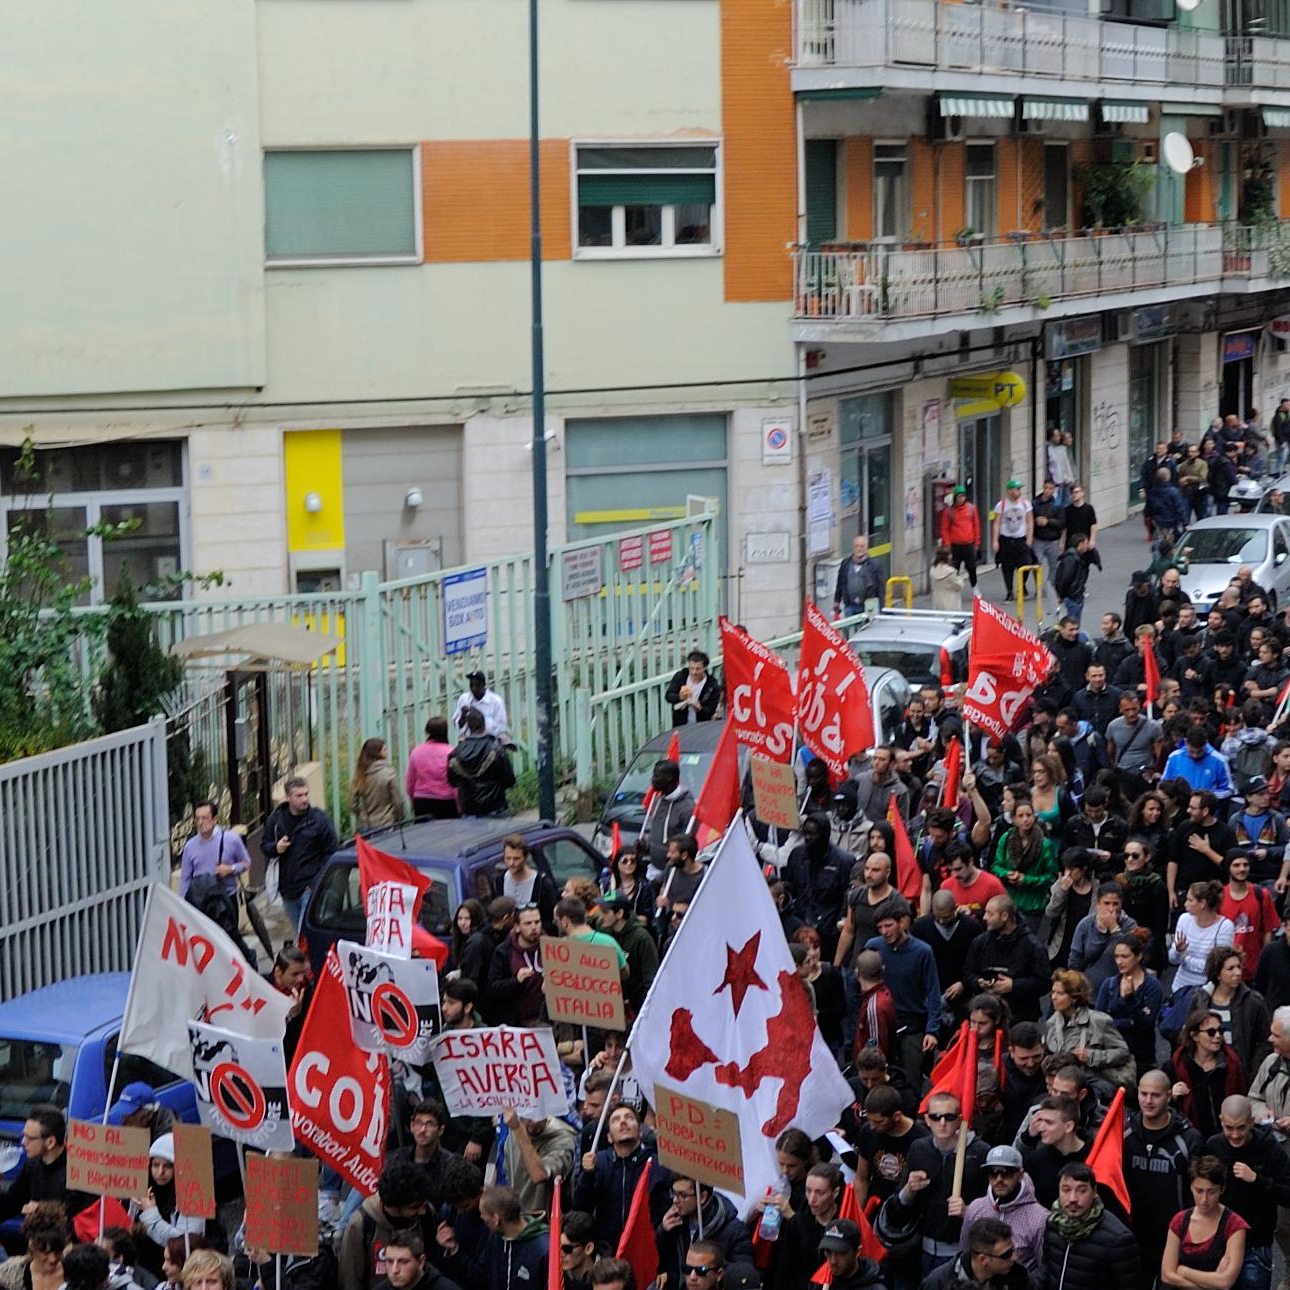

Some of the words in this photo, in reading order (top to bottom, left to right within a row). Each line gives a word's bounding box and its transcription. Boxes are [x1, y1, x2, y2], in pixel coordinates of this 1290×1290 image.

[994, 382, 1018, 398] PT
[161, 916, 215, 976] NO
[544, 943, 571, 964] NO
[580, 954, 611, 971] ALLO
[549, 969, 623, 995] SBLOCCA
[555, 996, 615, 1019] ITALIA
[438, 1032, 545, 1062] ISKRA
[455, 1062, 558, 1098] AVERSA
[73, 1124, 97, 1142] NO
[105, 1128, 125, 1146] AL
[658, 1113, 727, 1152] PUBBLICA
[1132, 1155, 1170, 1173] PUMA
[70, 1165, 80, 1181] DI
[87, 1168, 139, 1190] BAGNOLI
